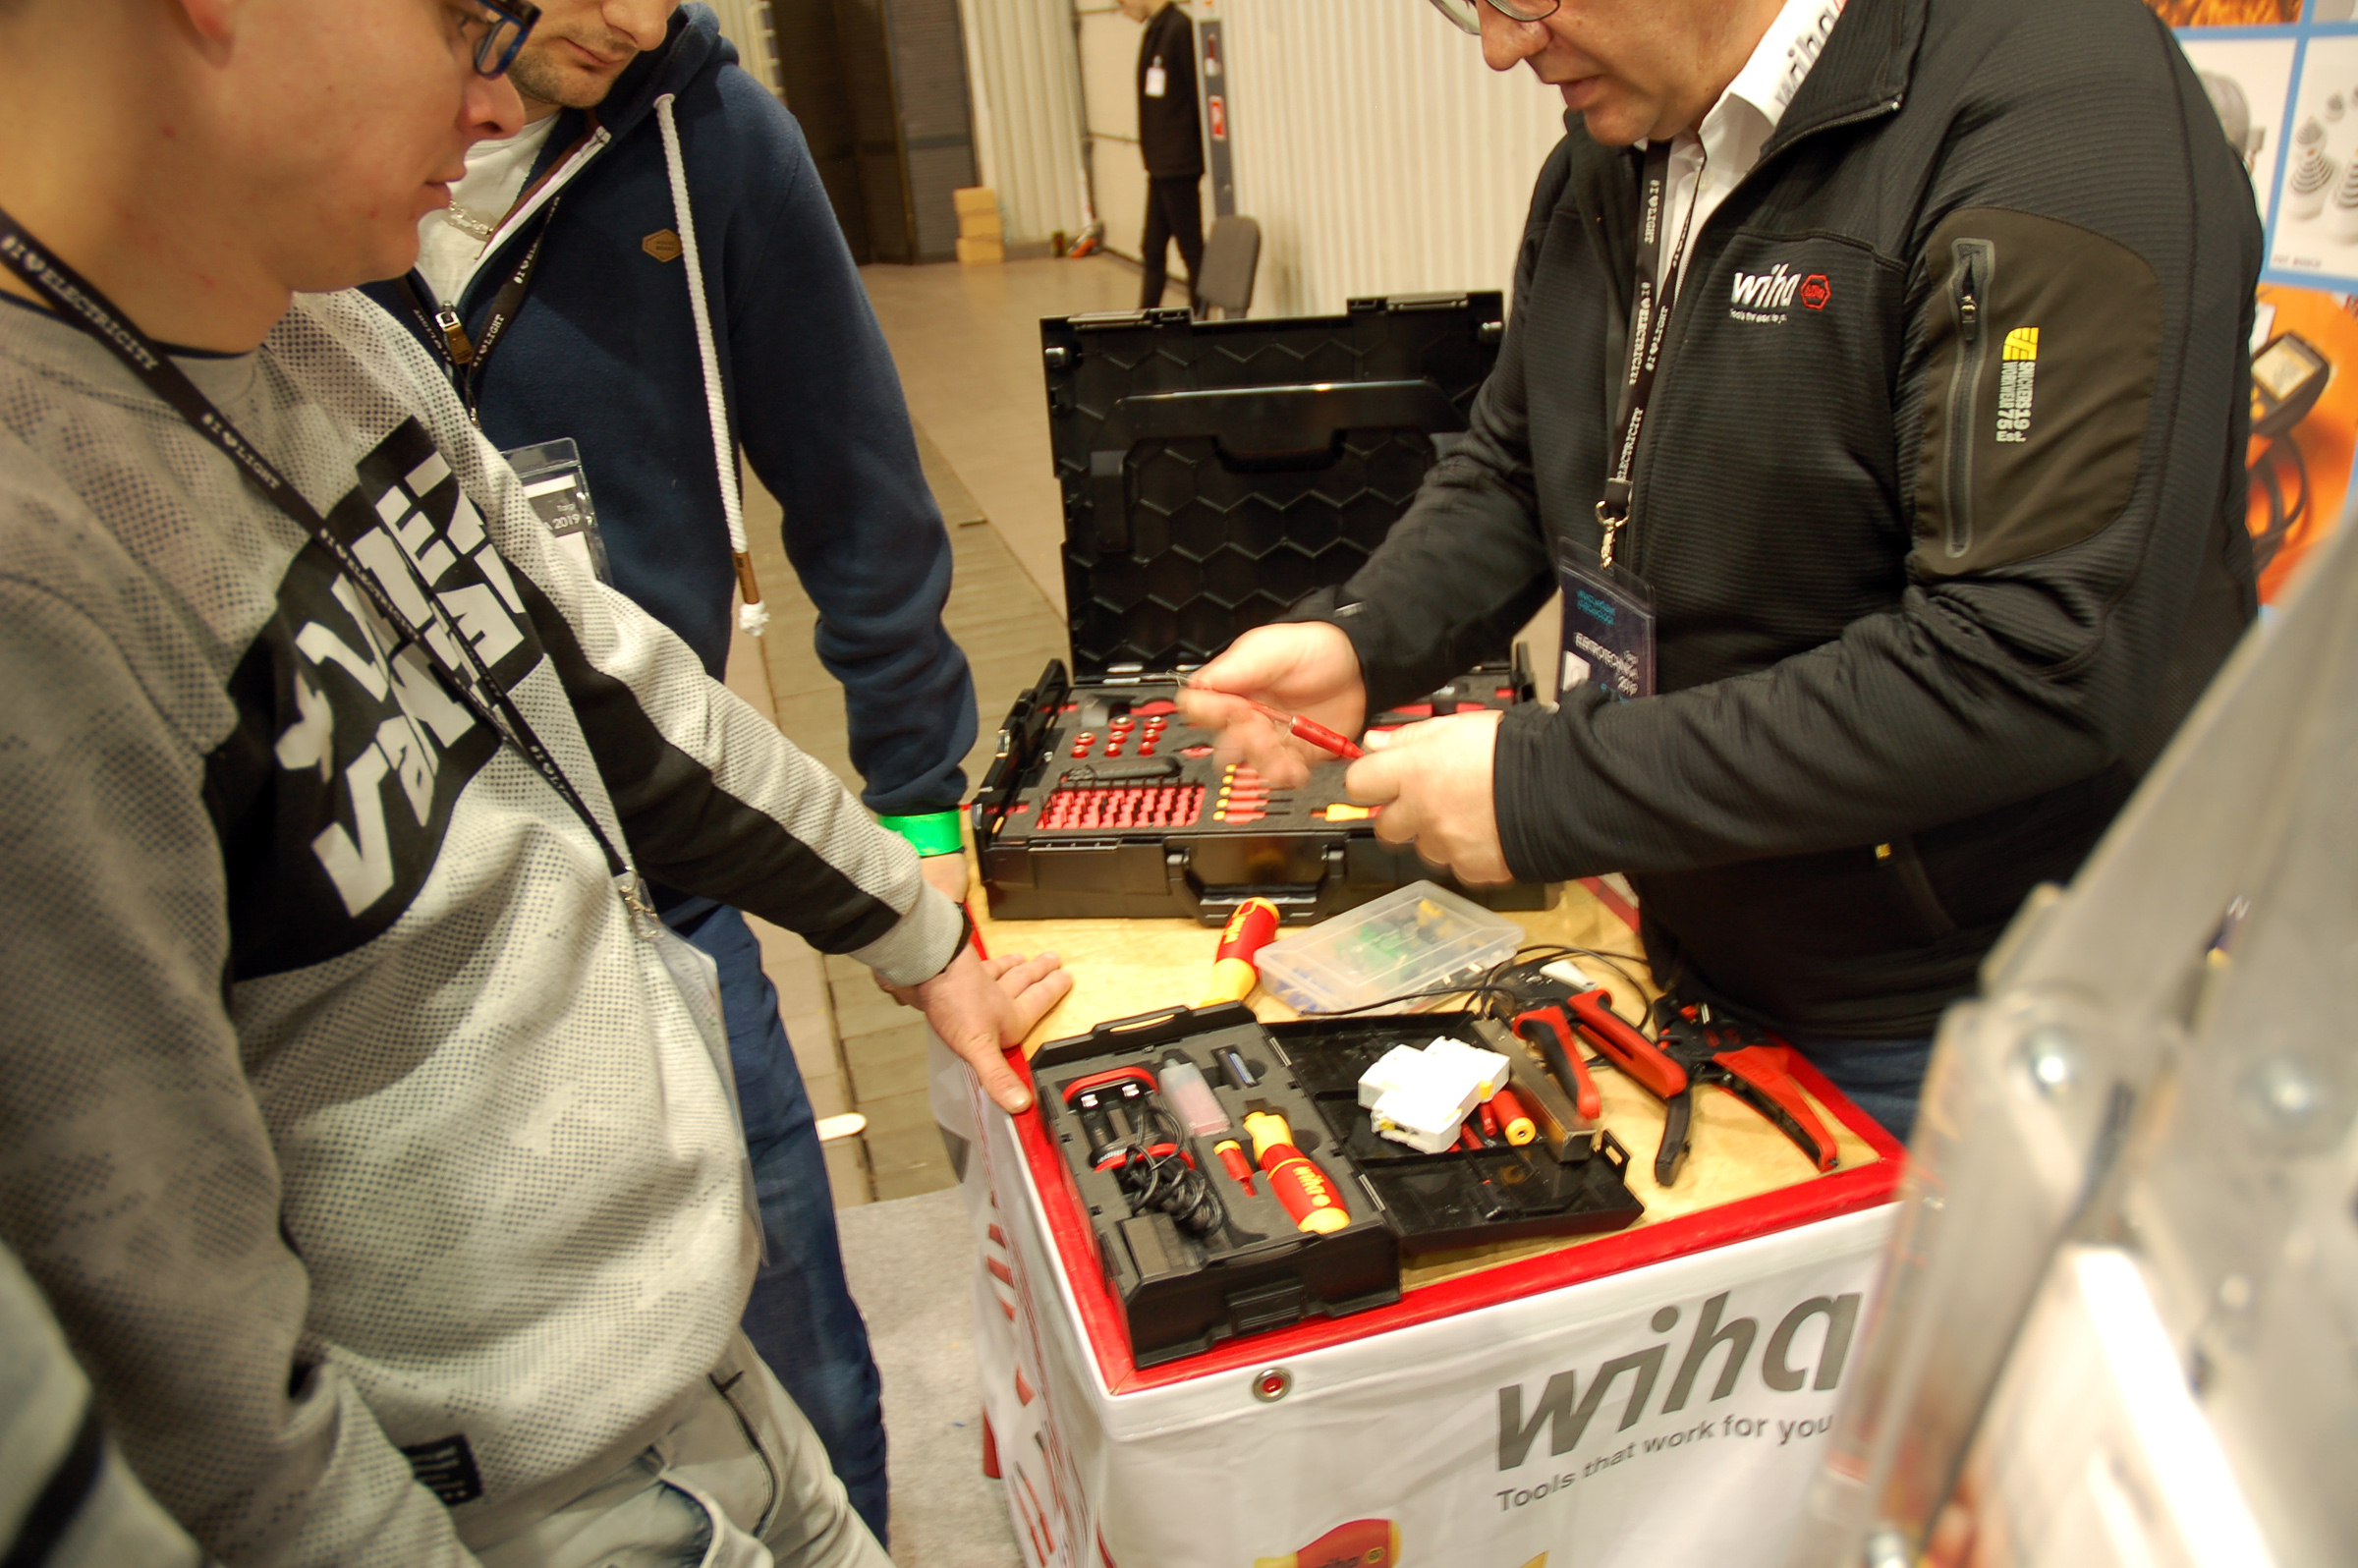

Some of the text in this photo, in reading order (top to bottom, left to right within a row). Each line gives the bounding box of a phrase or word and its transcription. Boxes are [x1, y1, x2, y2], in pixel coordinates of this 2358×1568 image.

[1644, 207, 1657, 245] LIGHT
[1731, 262, 1802, 308] wiha
[38, 267, 159, 370] ELECTRICITY
[486, 313, 504, 346] LIGHT
[1652, 305, 1668, 345] LIGHT
[1629, 308, 1651, 386] ELECTRICITY
[1995, 361, 2019, 430] WORKWEAR 75
[2013, 361, 2037, 430] SNICKERS 19
[236, 445, 281, 490] LIGHT
[552, 513, 581, 530] 2019
[1292, 1165, 1326, 1196] wiha
[1498, 1290, 1863, 1472] wiha
[1495, 1414, 1834, 1512] Tools that work for you
